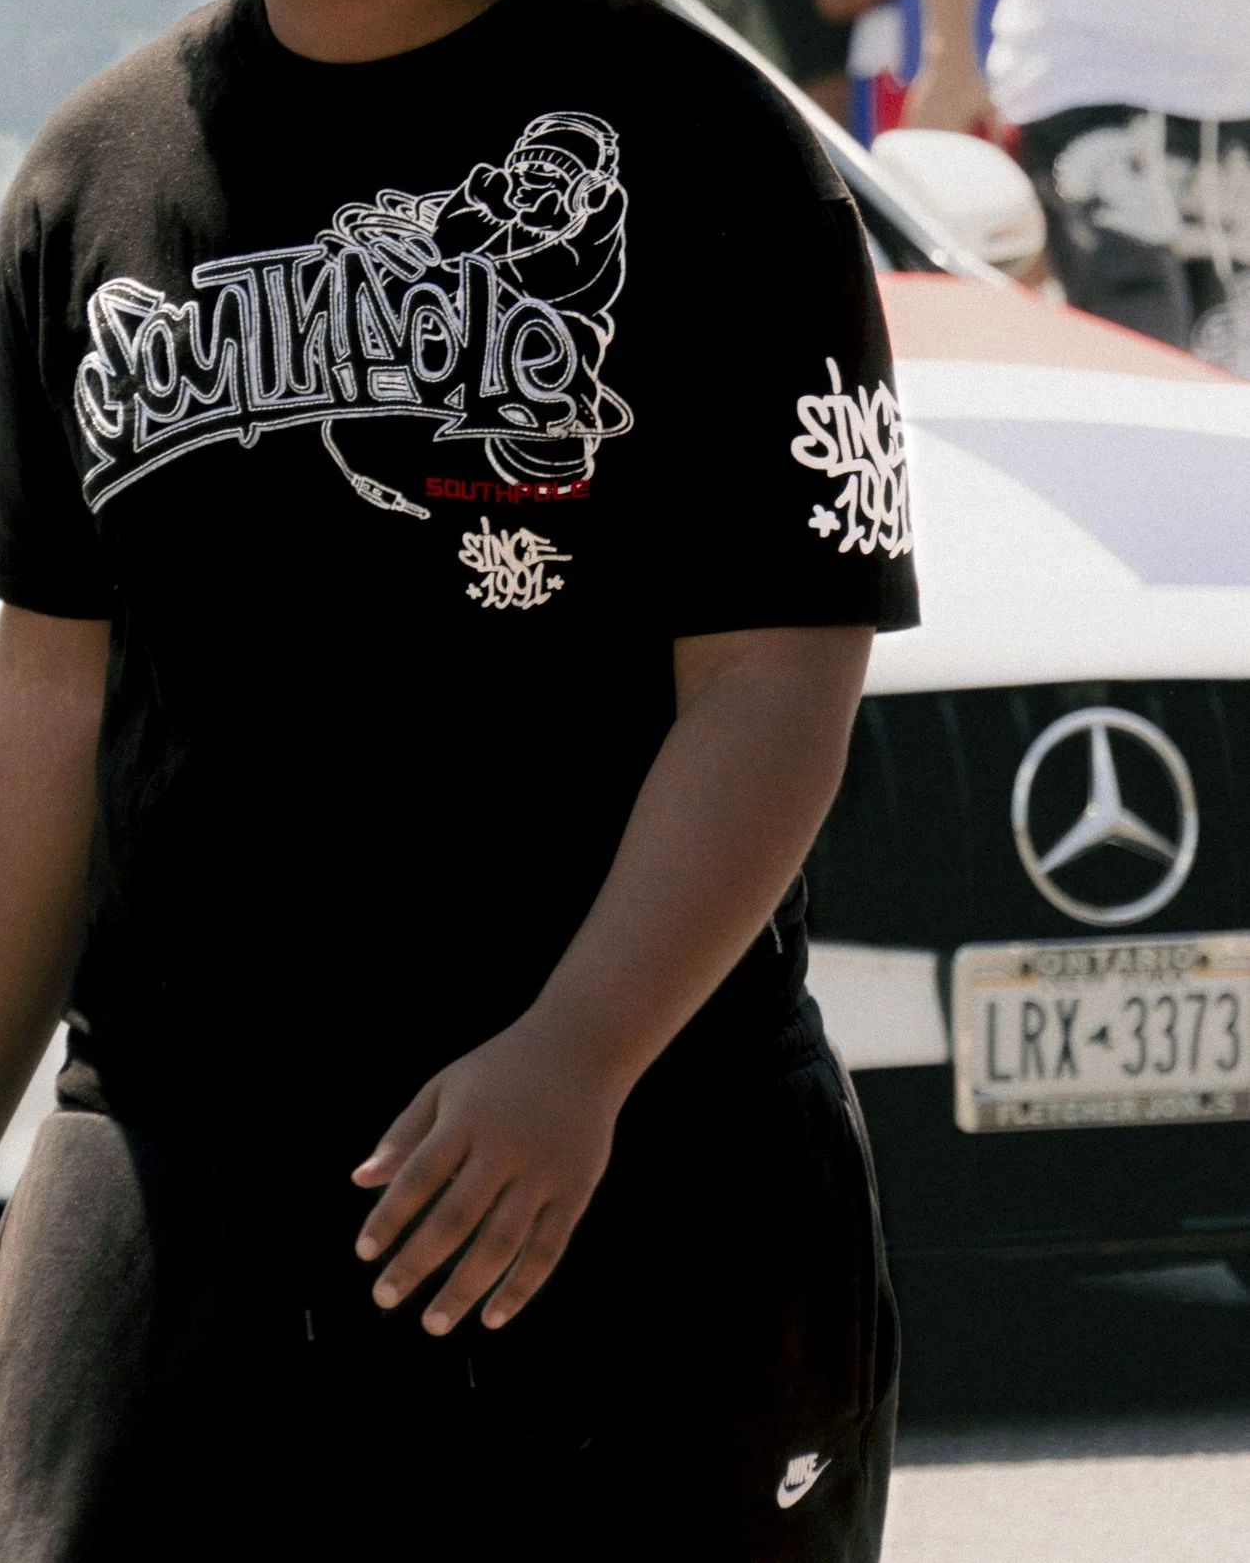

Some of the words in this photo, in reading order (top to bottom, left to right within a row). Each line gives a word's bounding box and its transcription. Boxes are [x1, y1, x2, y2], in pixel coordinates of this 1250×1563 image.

[425, 476, 591, 504] SOUTHPOLE
[457, 515, 573, 573] SINCE
[479, 562, 552, 610] 1991
